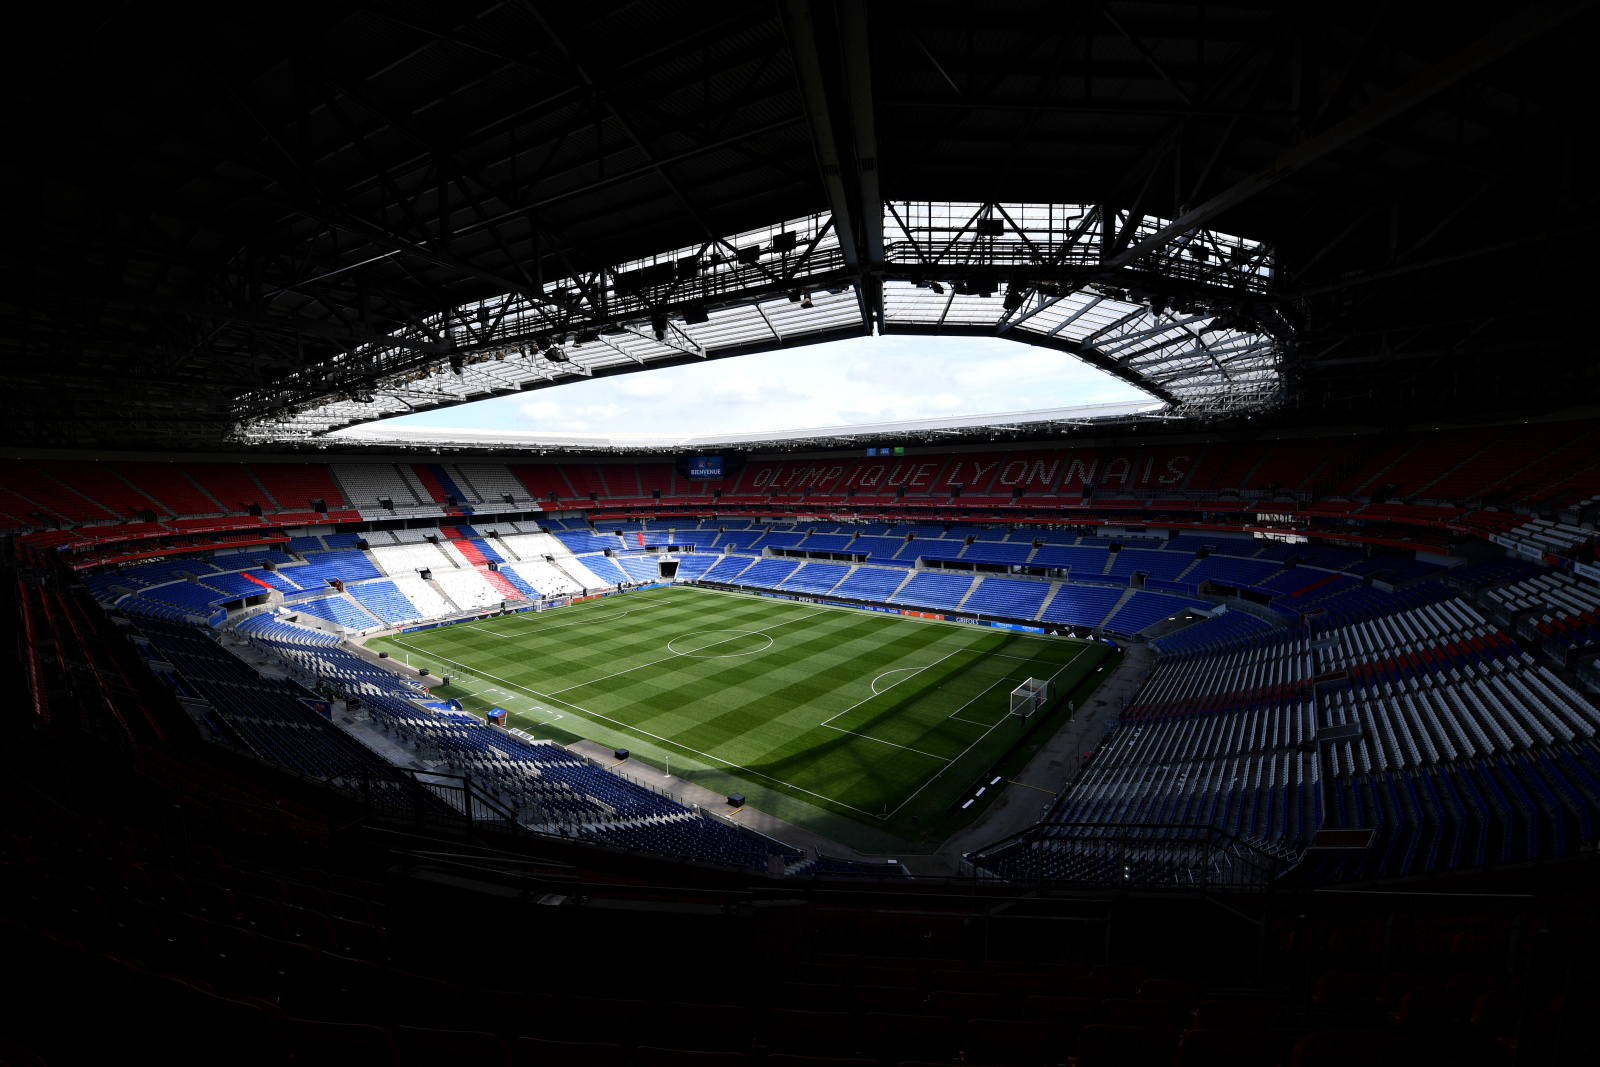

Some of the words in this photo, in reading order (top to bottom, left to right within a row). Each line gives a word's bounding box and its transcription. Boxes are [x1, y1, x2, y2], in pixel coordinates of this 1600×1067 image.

[690, 468, 722, 476] BIENVENUE
[753, 463, 938, 487] OLYMPIQUE
[946, 456, 1190, 485] LYONNAIS
[955, 617, 979, 625] GRIFOLS
